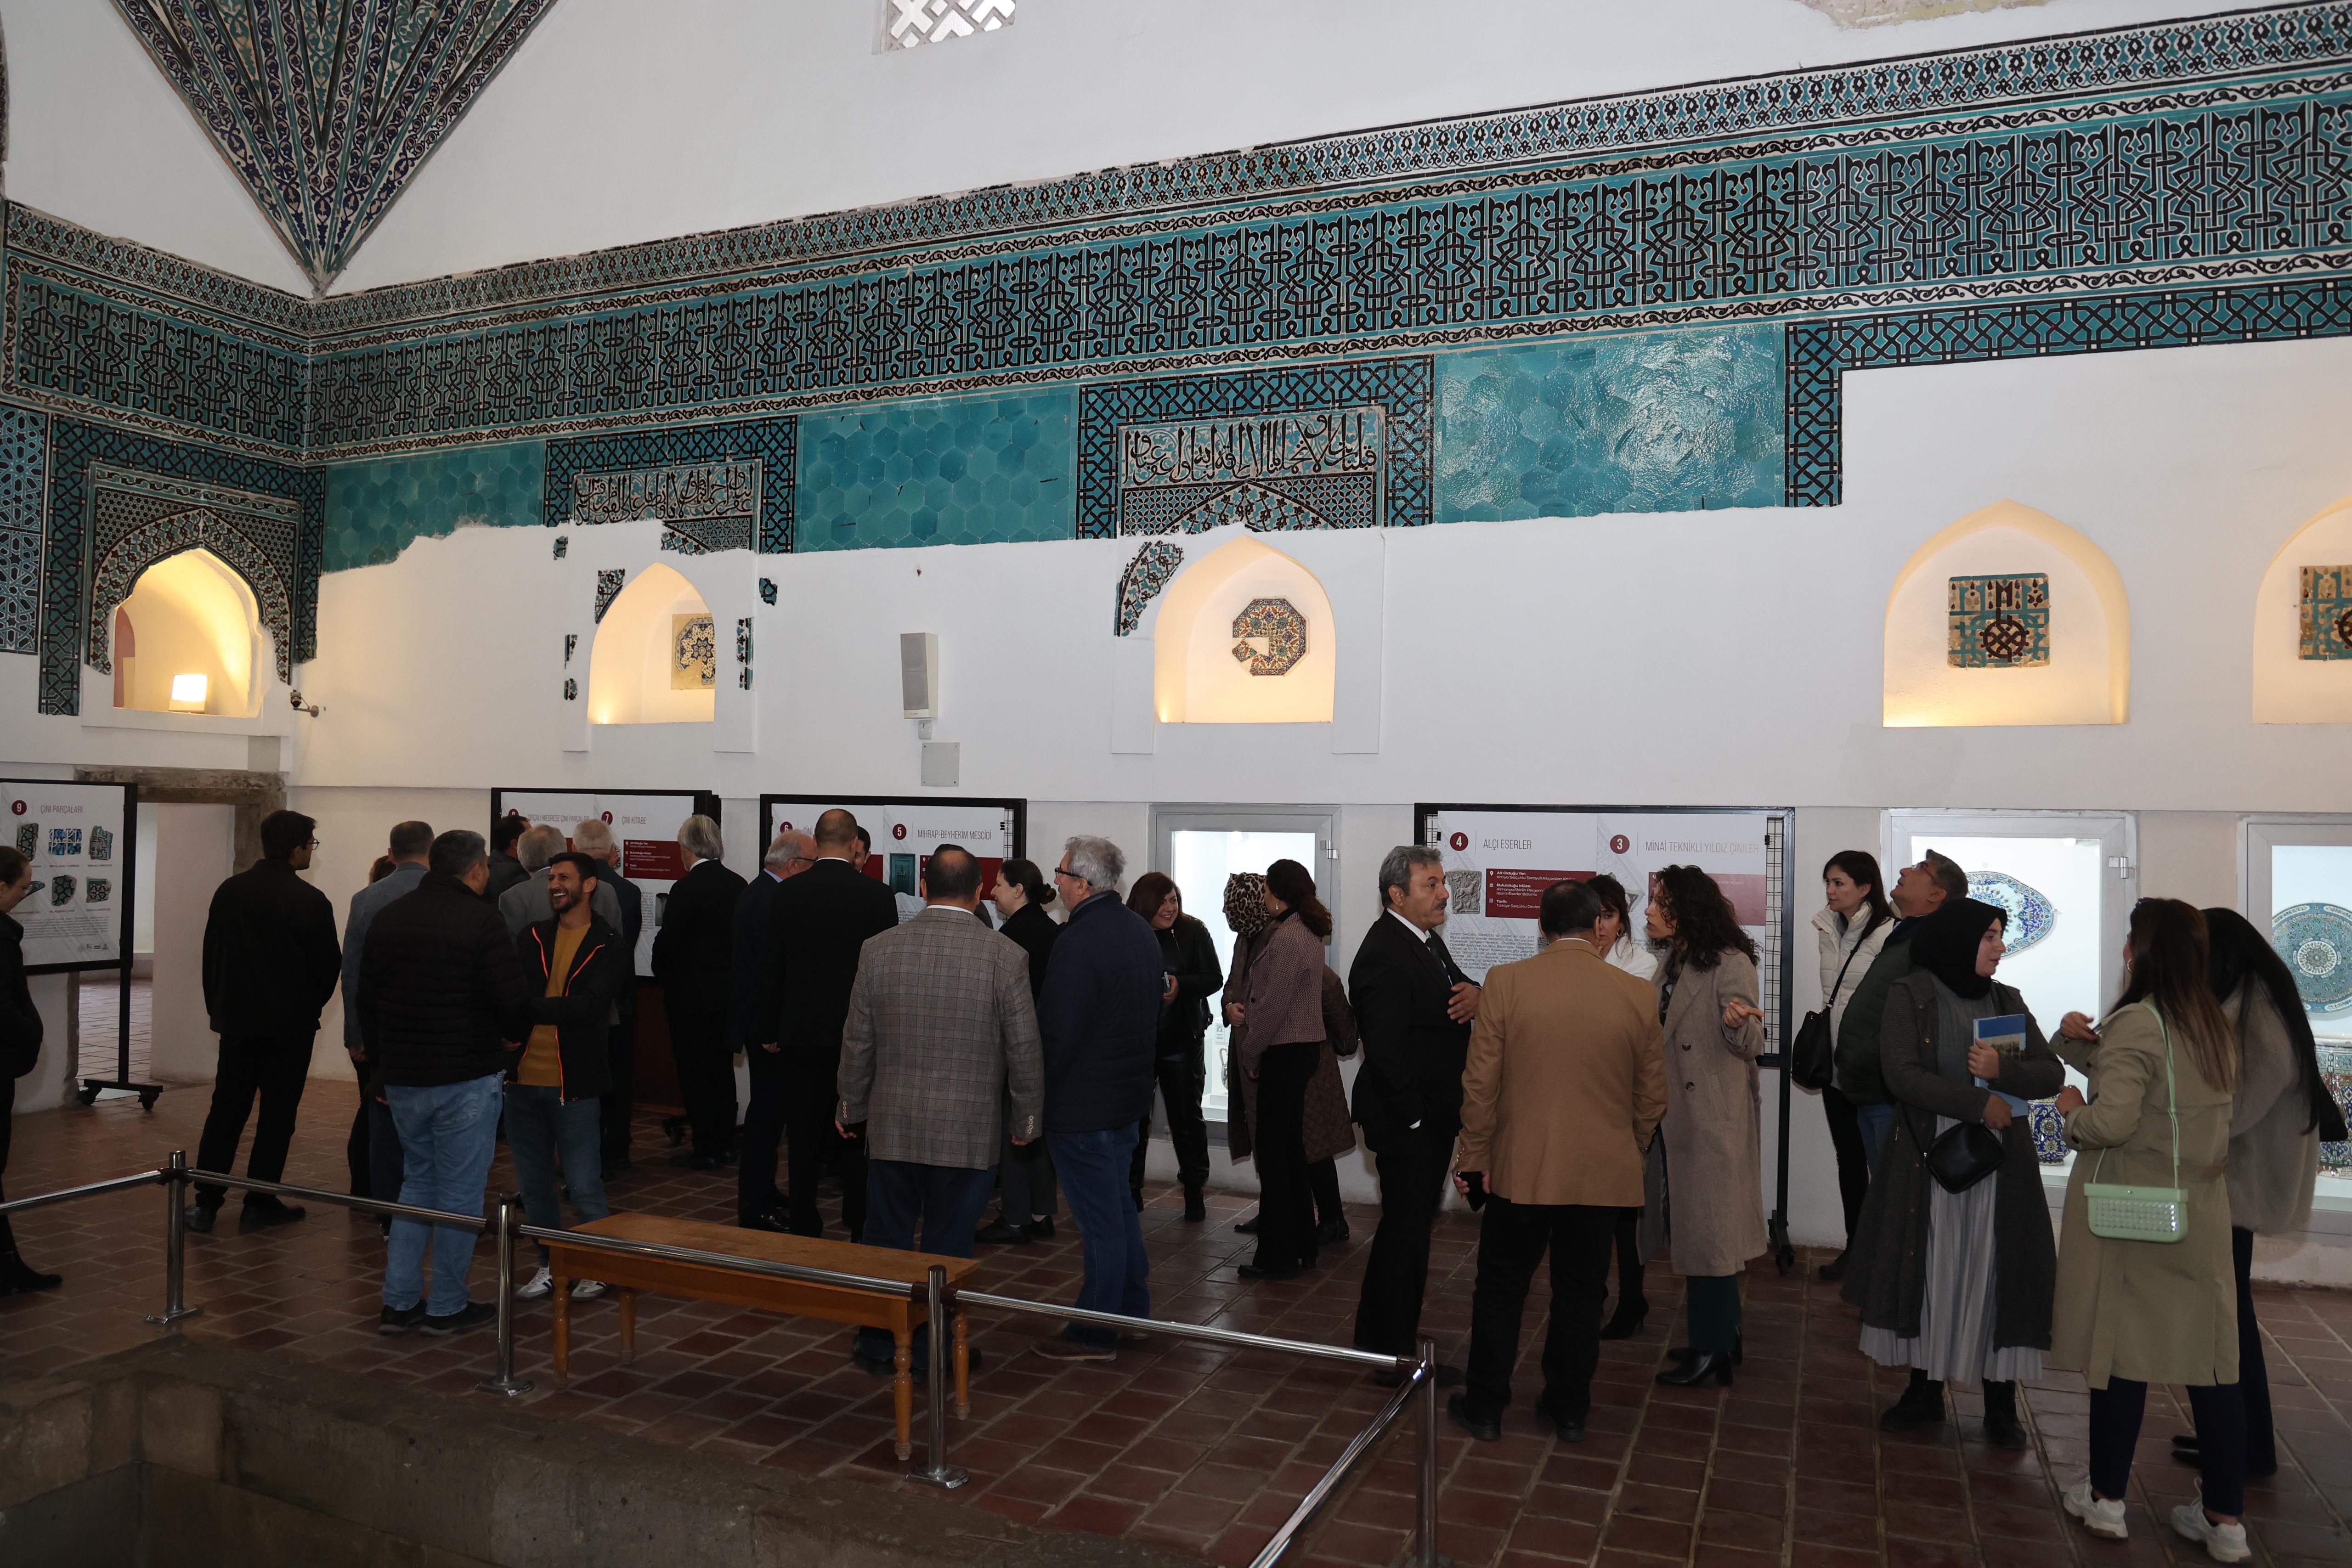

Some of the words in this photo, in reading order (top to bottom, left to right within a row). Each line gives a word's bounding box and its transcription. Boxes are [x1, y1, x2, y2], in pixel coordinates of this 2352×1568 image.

[17, 803, 22, 812] 9
[52, 805, 83, 814] PARÇALARI
[605, 814, 609, 823] 7
[631, 815, 647, 824] KİTABE
[897, 827, 902, 836] 5
[918, 829, 968, 840] MİHRAP-BEYHEKİM
[969, 829, 992, 840] MESCİDİ
[1456, 836, 1462, 847] 4
[1483, 839, 1498, 850] ALÇI
[1501, 839, 1532, 849] ESERLER
[1617, 838, 1623, 850] 3
[1645, 840, 1667, 852] MİNAİ
[1669, 840, 1702, 852] TEKNİKLİ
[1704, 842, 1728, 853] YILDIZ
